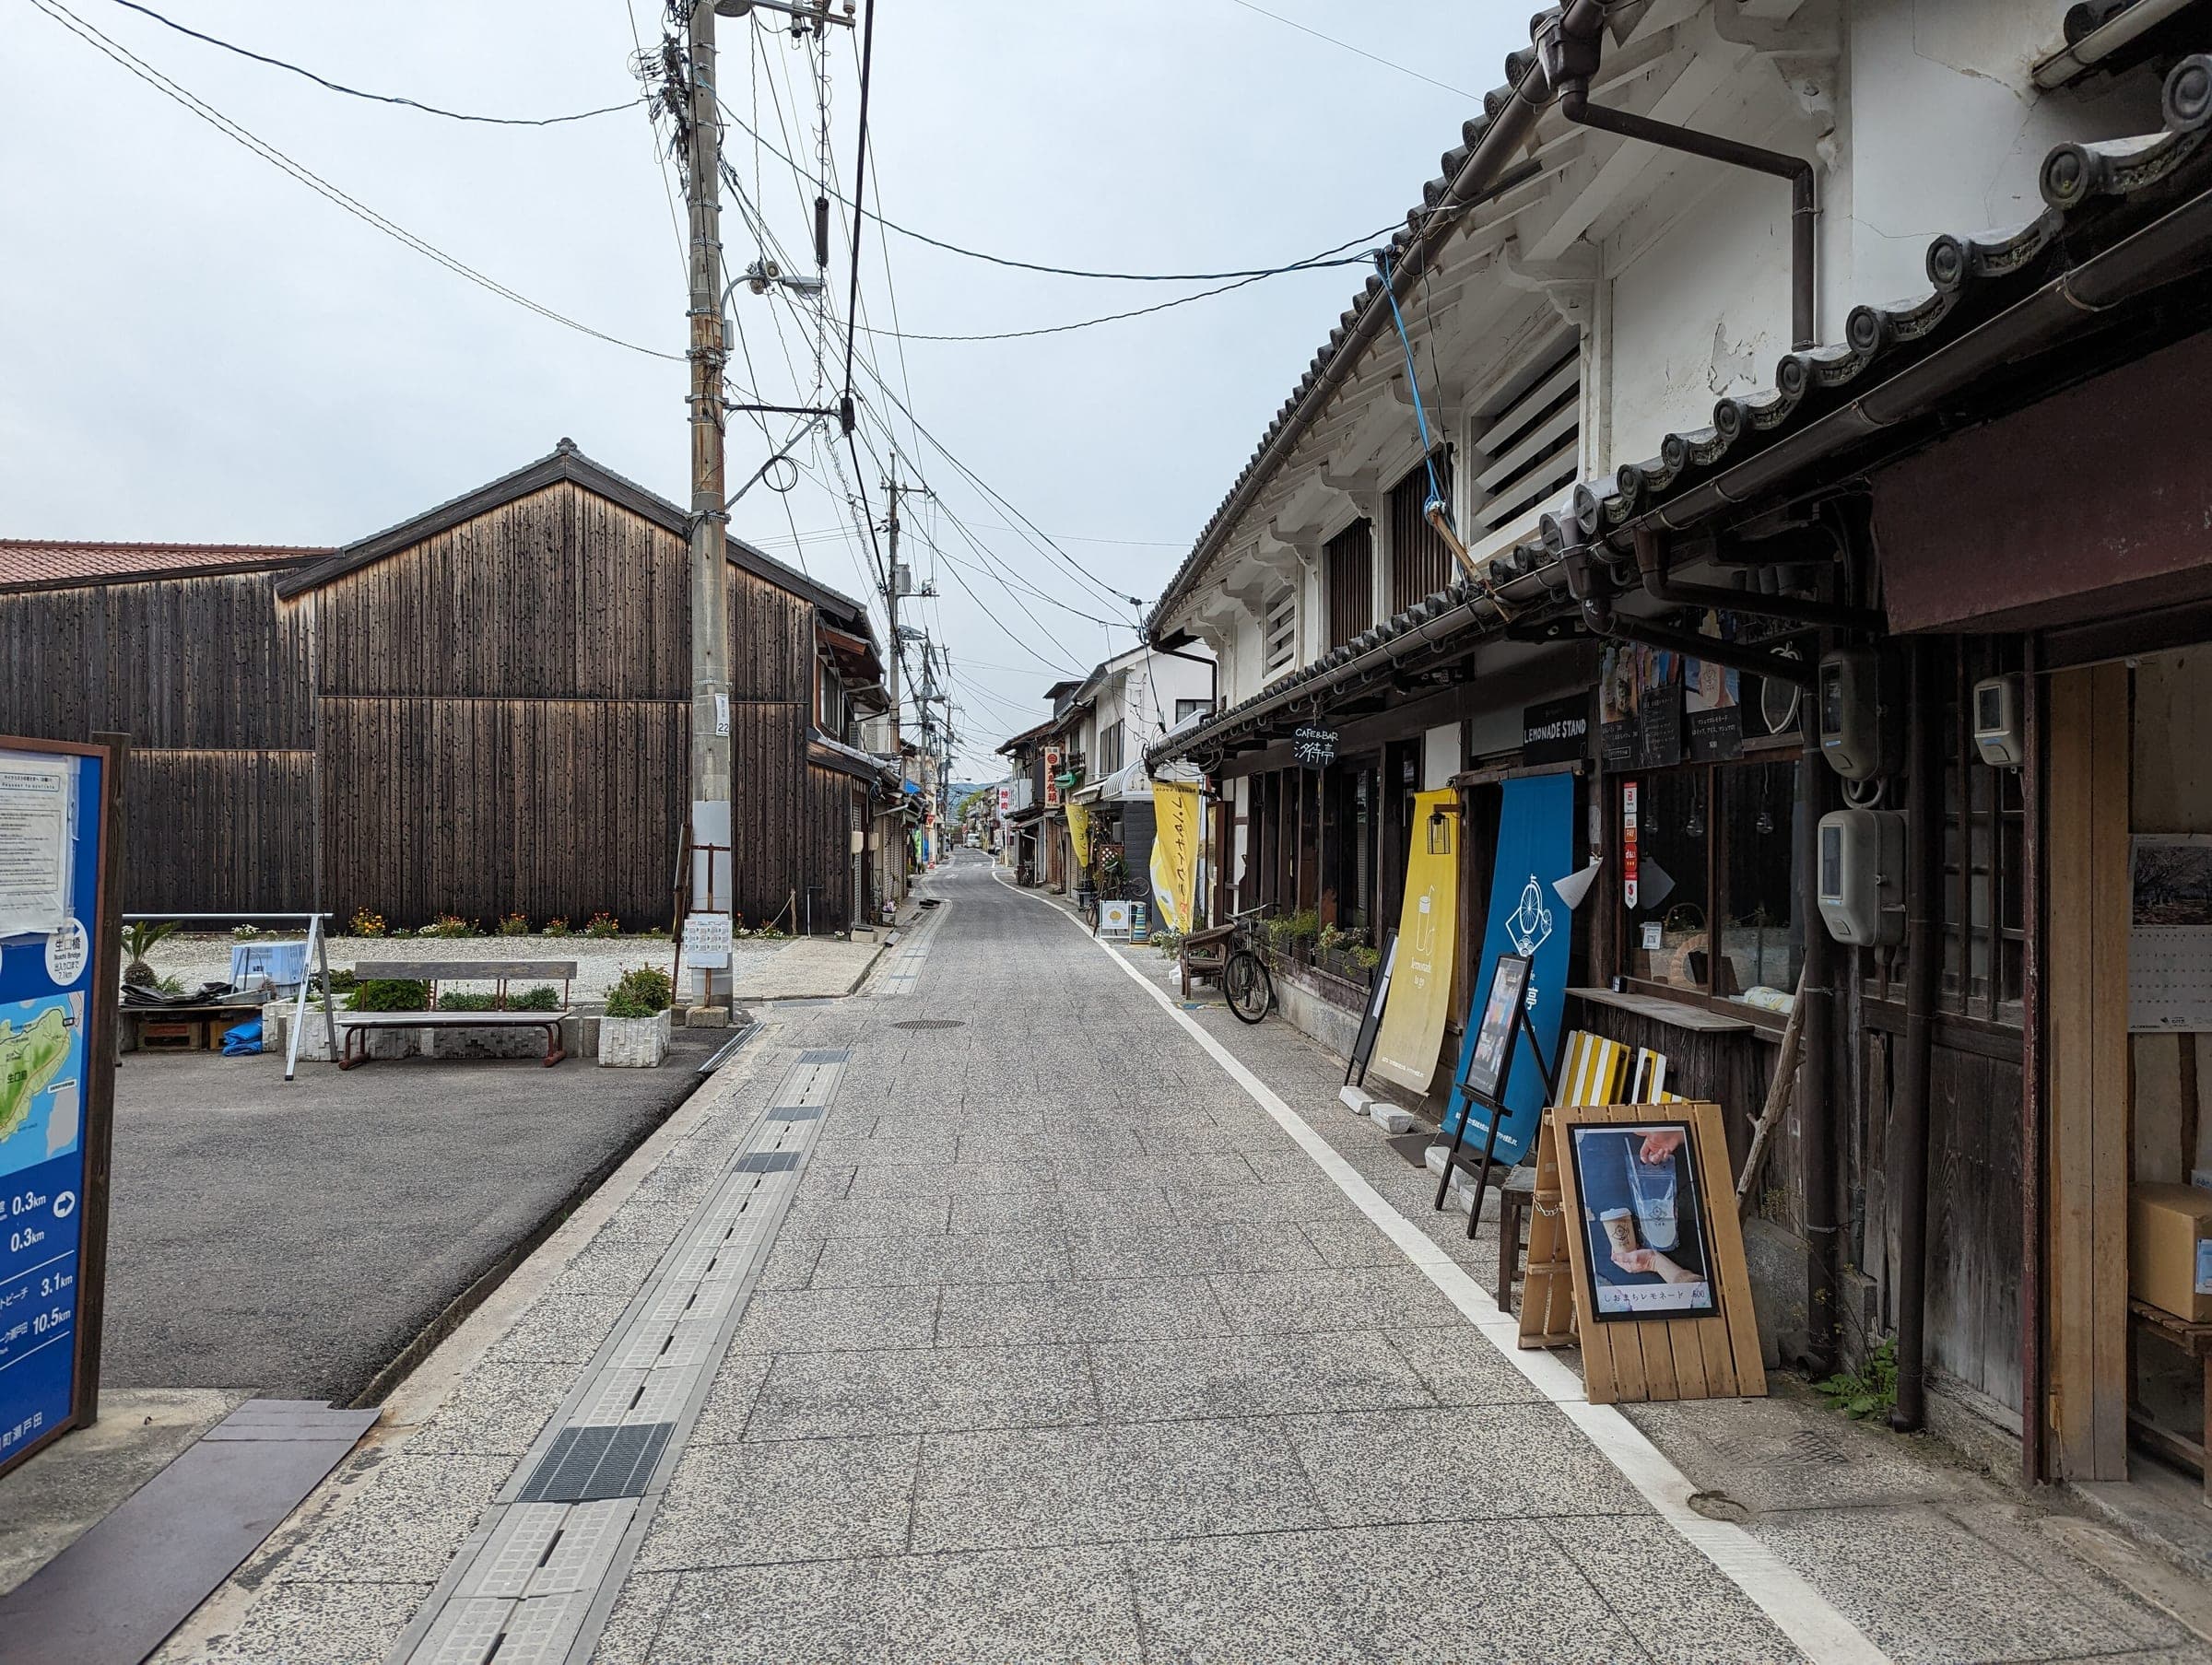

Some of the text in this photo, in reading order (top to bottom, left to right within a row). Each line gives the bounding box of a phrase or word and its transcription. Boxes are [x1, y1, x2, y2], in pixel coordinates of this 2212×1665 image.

[718, 722, 729, 733] 22
[1295, 728, 1339, 742] CAFE&BAR
[1524, 721, 1561, 744] LEMONADE
[1562, 719, 1586, 738] STAND
[54, 936, 81, 952] 生口橋
[67, 952, 81, 960] Bridge
[12, 1190, 46, 1215] 0.3km
[10, 1227, 45, 1252] 0.3km
[40, 1272, 74, 1297] 3.1km
[32, 1307, 71, 1335] 10.5km
[0, 1412, 42, 1450] 町瀬戸田
